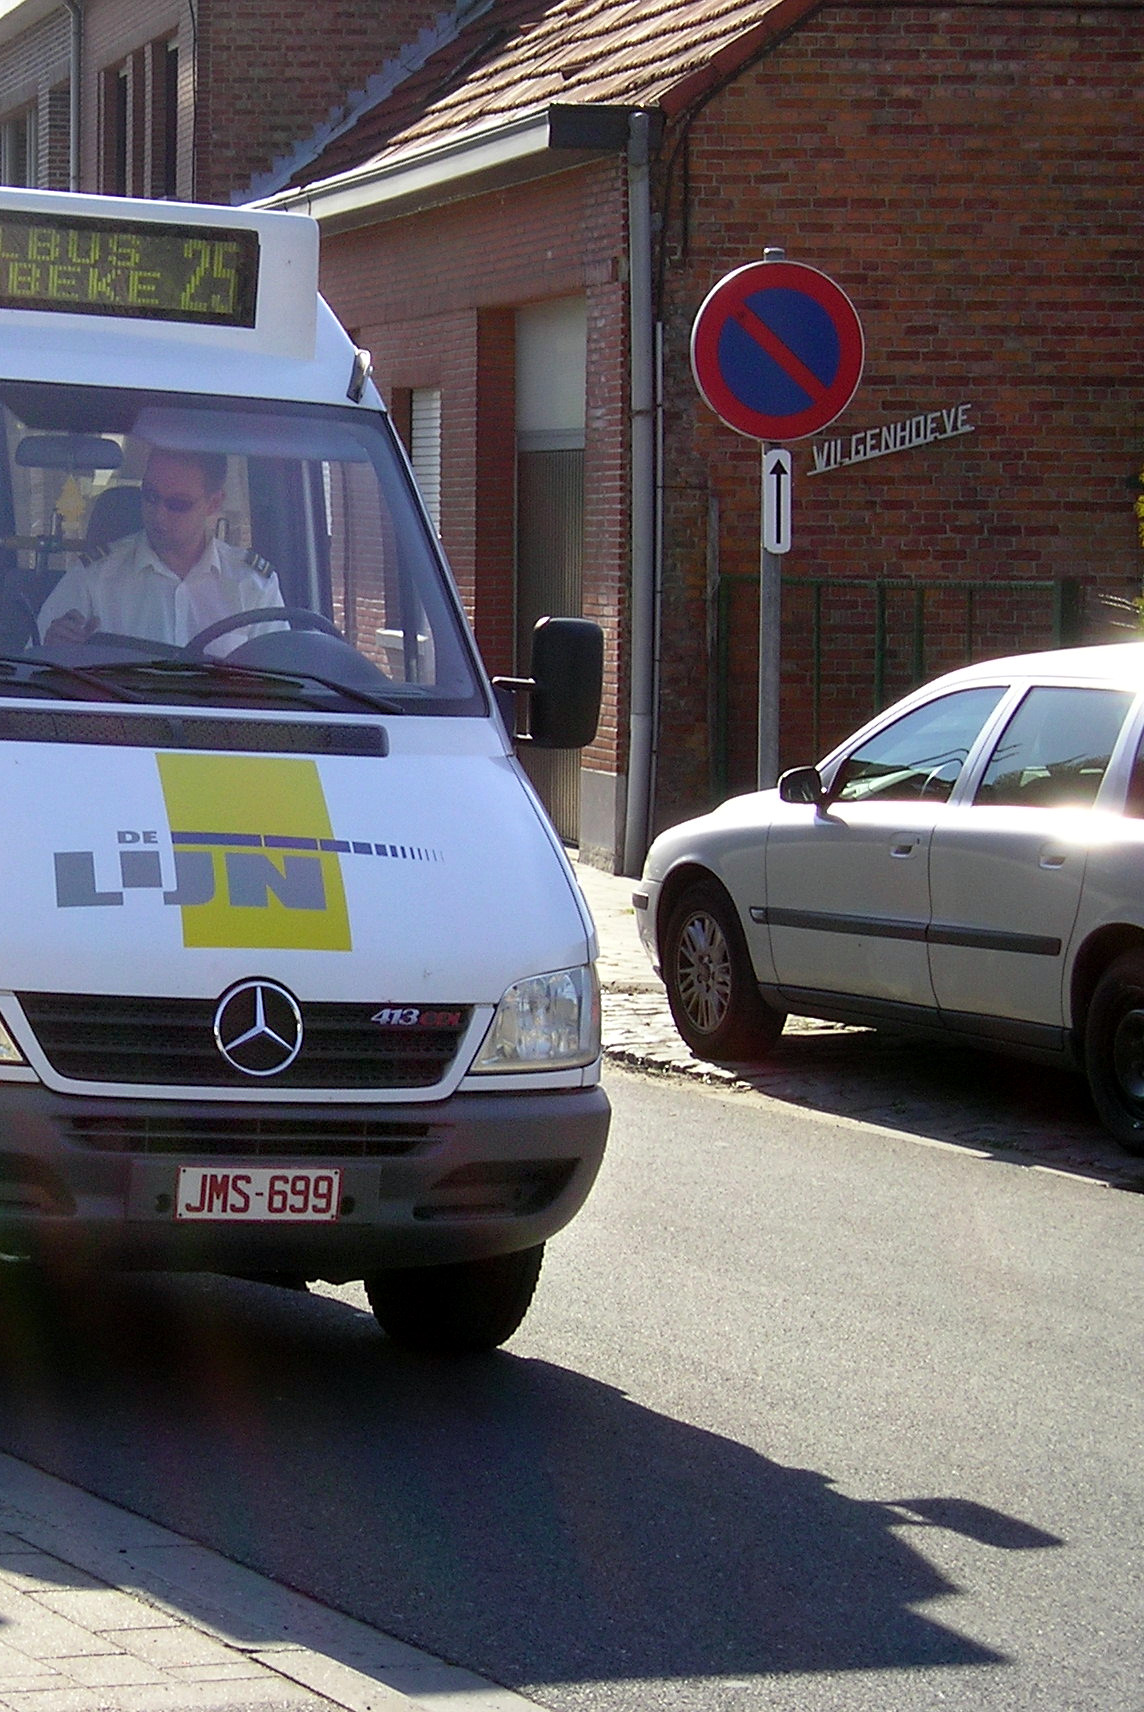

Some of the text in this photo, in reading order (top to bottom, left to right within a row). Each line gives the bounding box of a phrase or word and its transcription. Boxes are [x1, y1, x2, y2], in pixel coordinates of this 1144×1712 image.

[181, 239, 239, 314] 25
[812, 404, 973, 472] WILGENHOEVE
[117, 830, 158, 845] DE
[370, 1008, 420, 1026] 413
[185, 1174, 334, 1214] JMS-699
